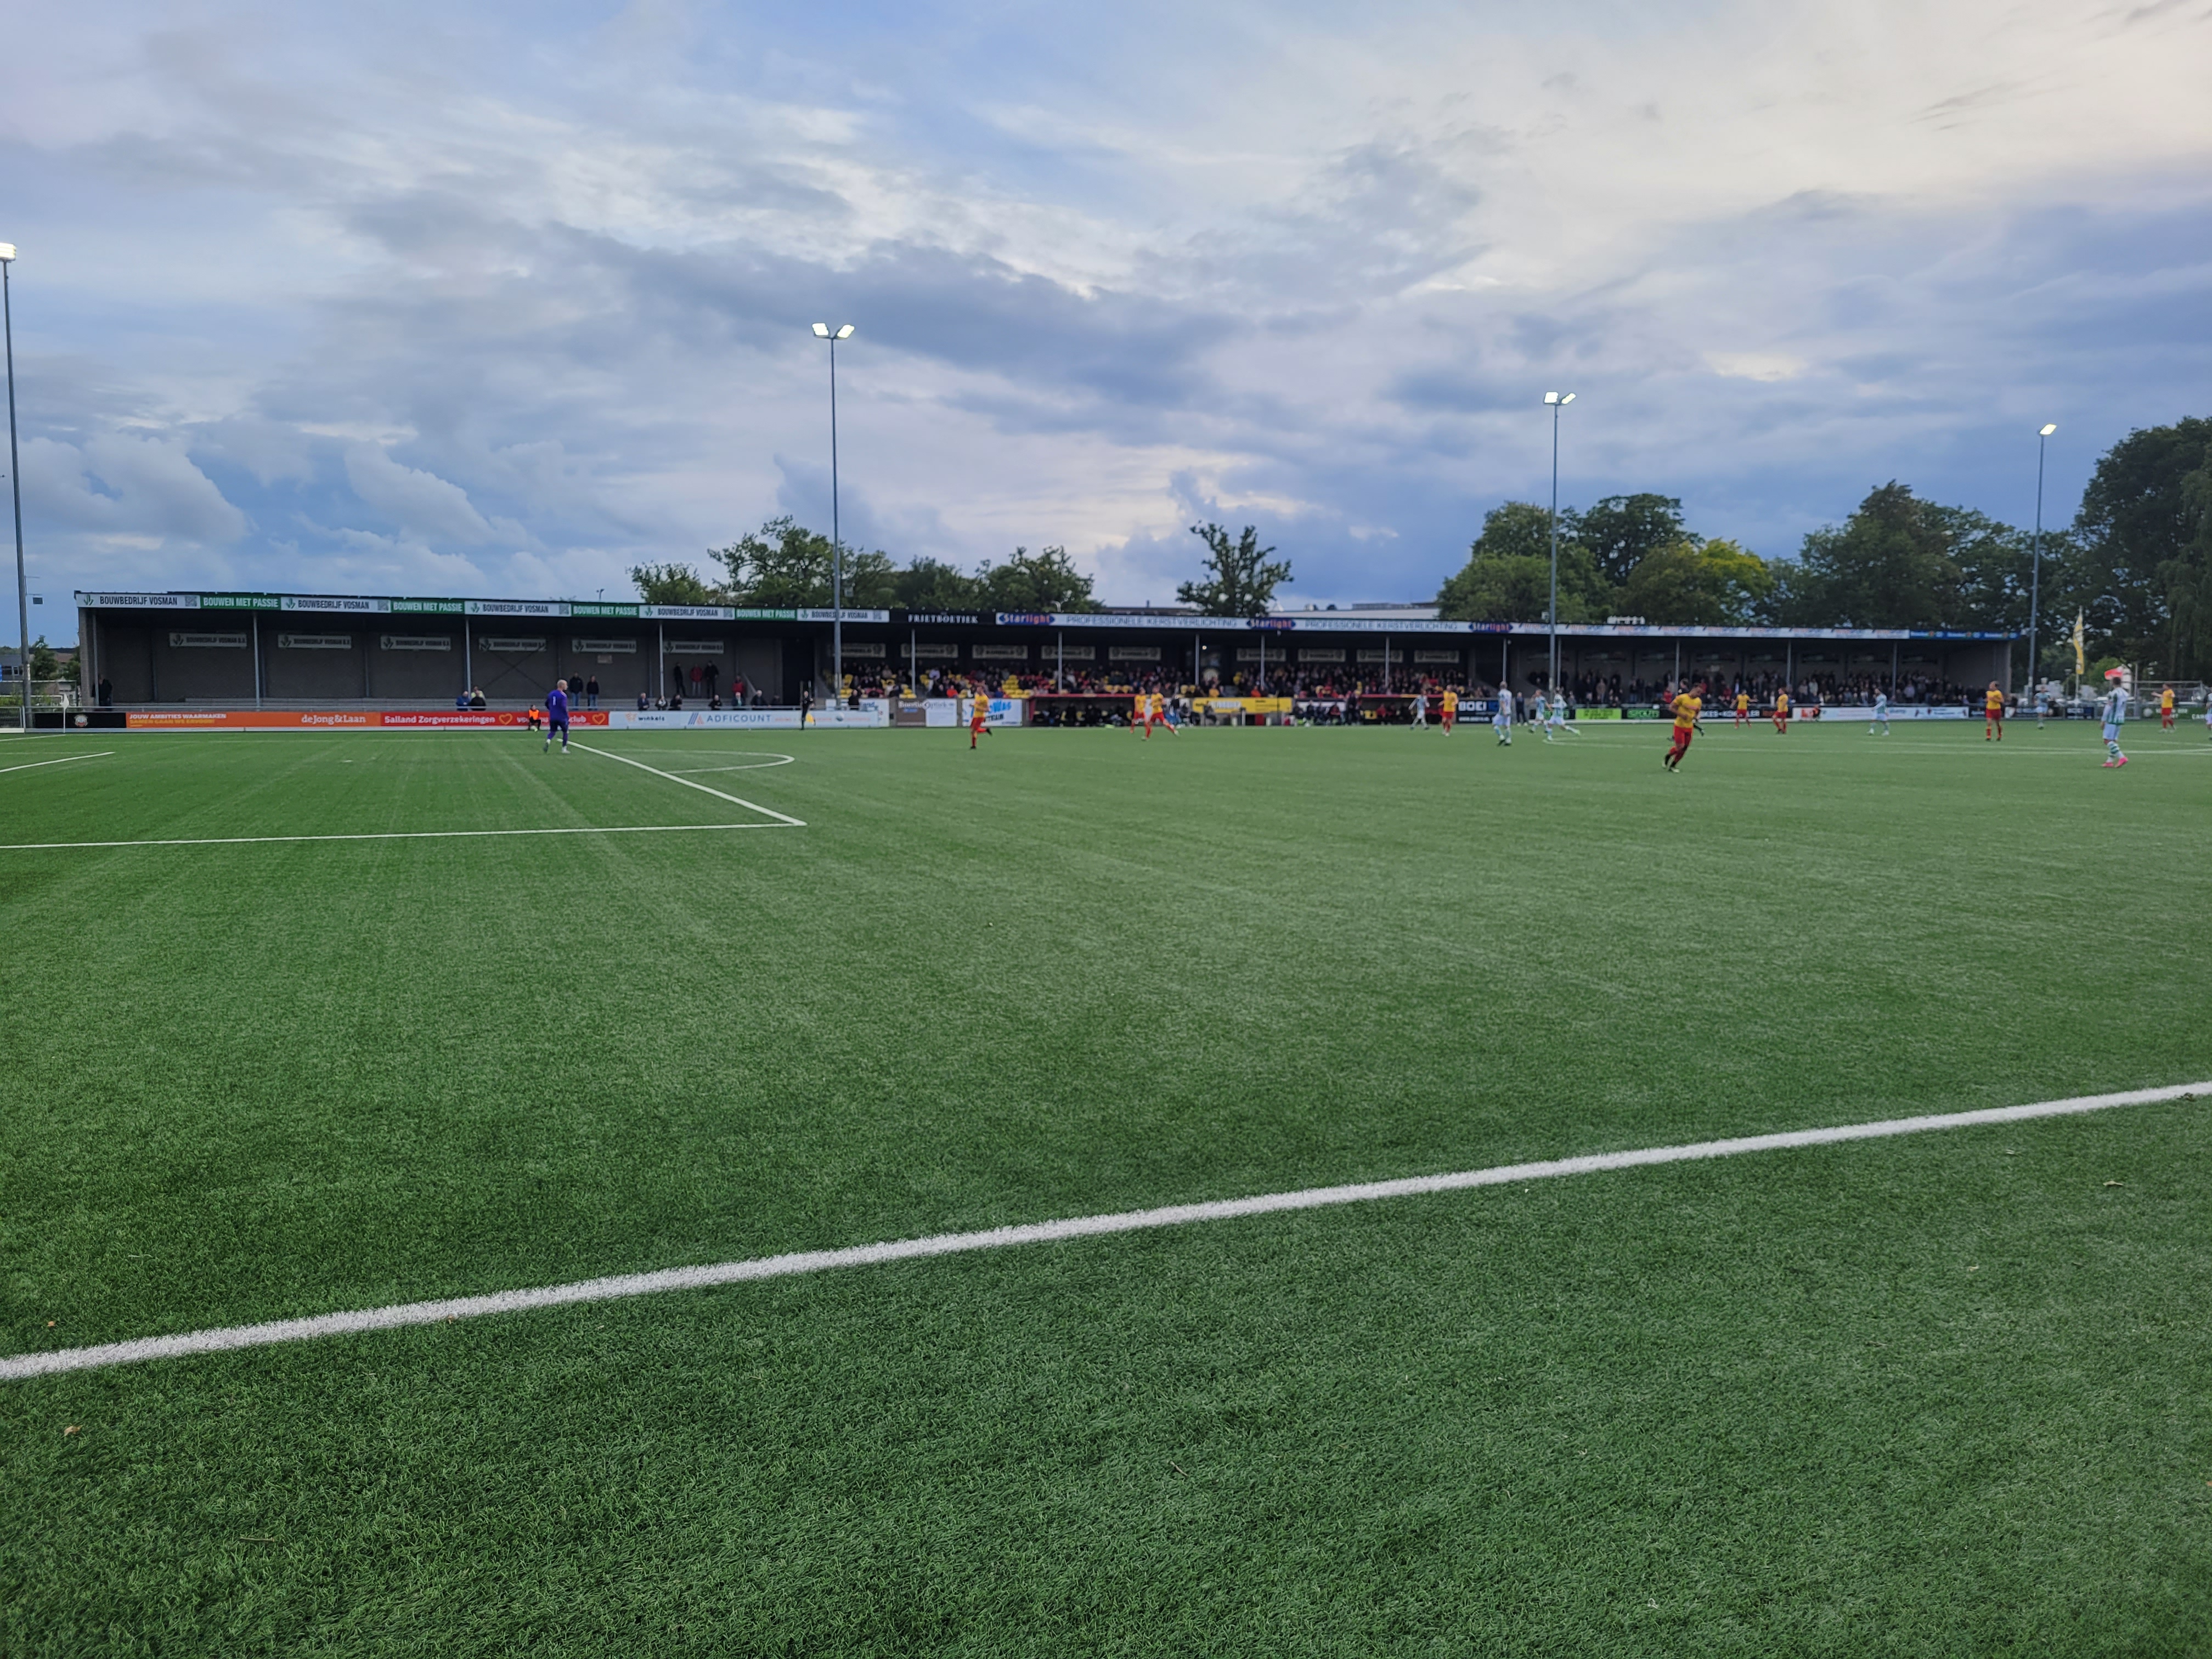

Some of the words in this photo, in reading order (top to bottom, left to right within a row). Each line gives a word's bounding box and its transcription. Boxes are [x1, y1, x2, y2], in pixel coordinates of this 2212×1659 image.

[99, 596, 148, 605] BOUWBEDRIJF
[149, 596, 178, 606] VOSMAN
[204, 596, 234, 607] BOUWEN
[236, 597, 251, 607] MET
[252, 598, 279, 608] PASSIE
[298, 599, 342, 609] BOUWBEDRIJF
[343, 600, 369, 610] VOSMAN
[393, 602, 422, 611] BOUWEN
[423, 602, 437, 611] MET
[439, 602, 463, 612] PASSIE
[482, 604, 523, 613] BOUWBEDRIJF
[524, 605, 549, 613] VOSMAN
[573, 605, 600, 614] BOUWEN
[601, 606, 614, 615] MET
[615, 606, 637, 616] PASSIE
[658, 608, 695, 616] BOUWBEDRIJF
[696, 608, 718, 617] VOSMAN
[1003, 613, 1049, 624] Starlight
[1249, 618, 1292, 629] Starlight
[384, 715, 416, 724] Salland
[418, 715, 495, 725] Zorgverzekeringen
[707, 714, 771, 723] ADFICOUNT
